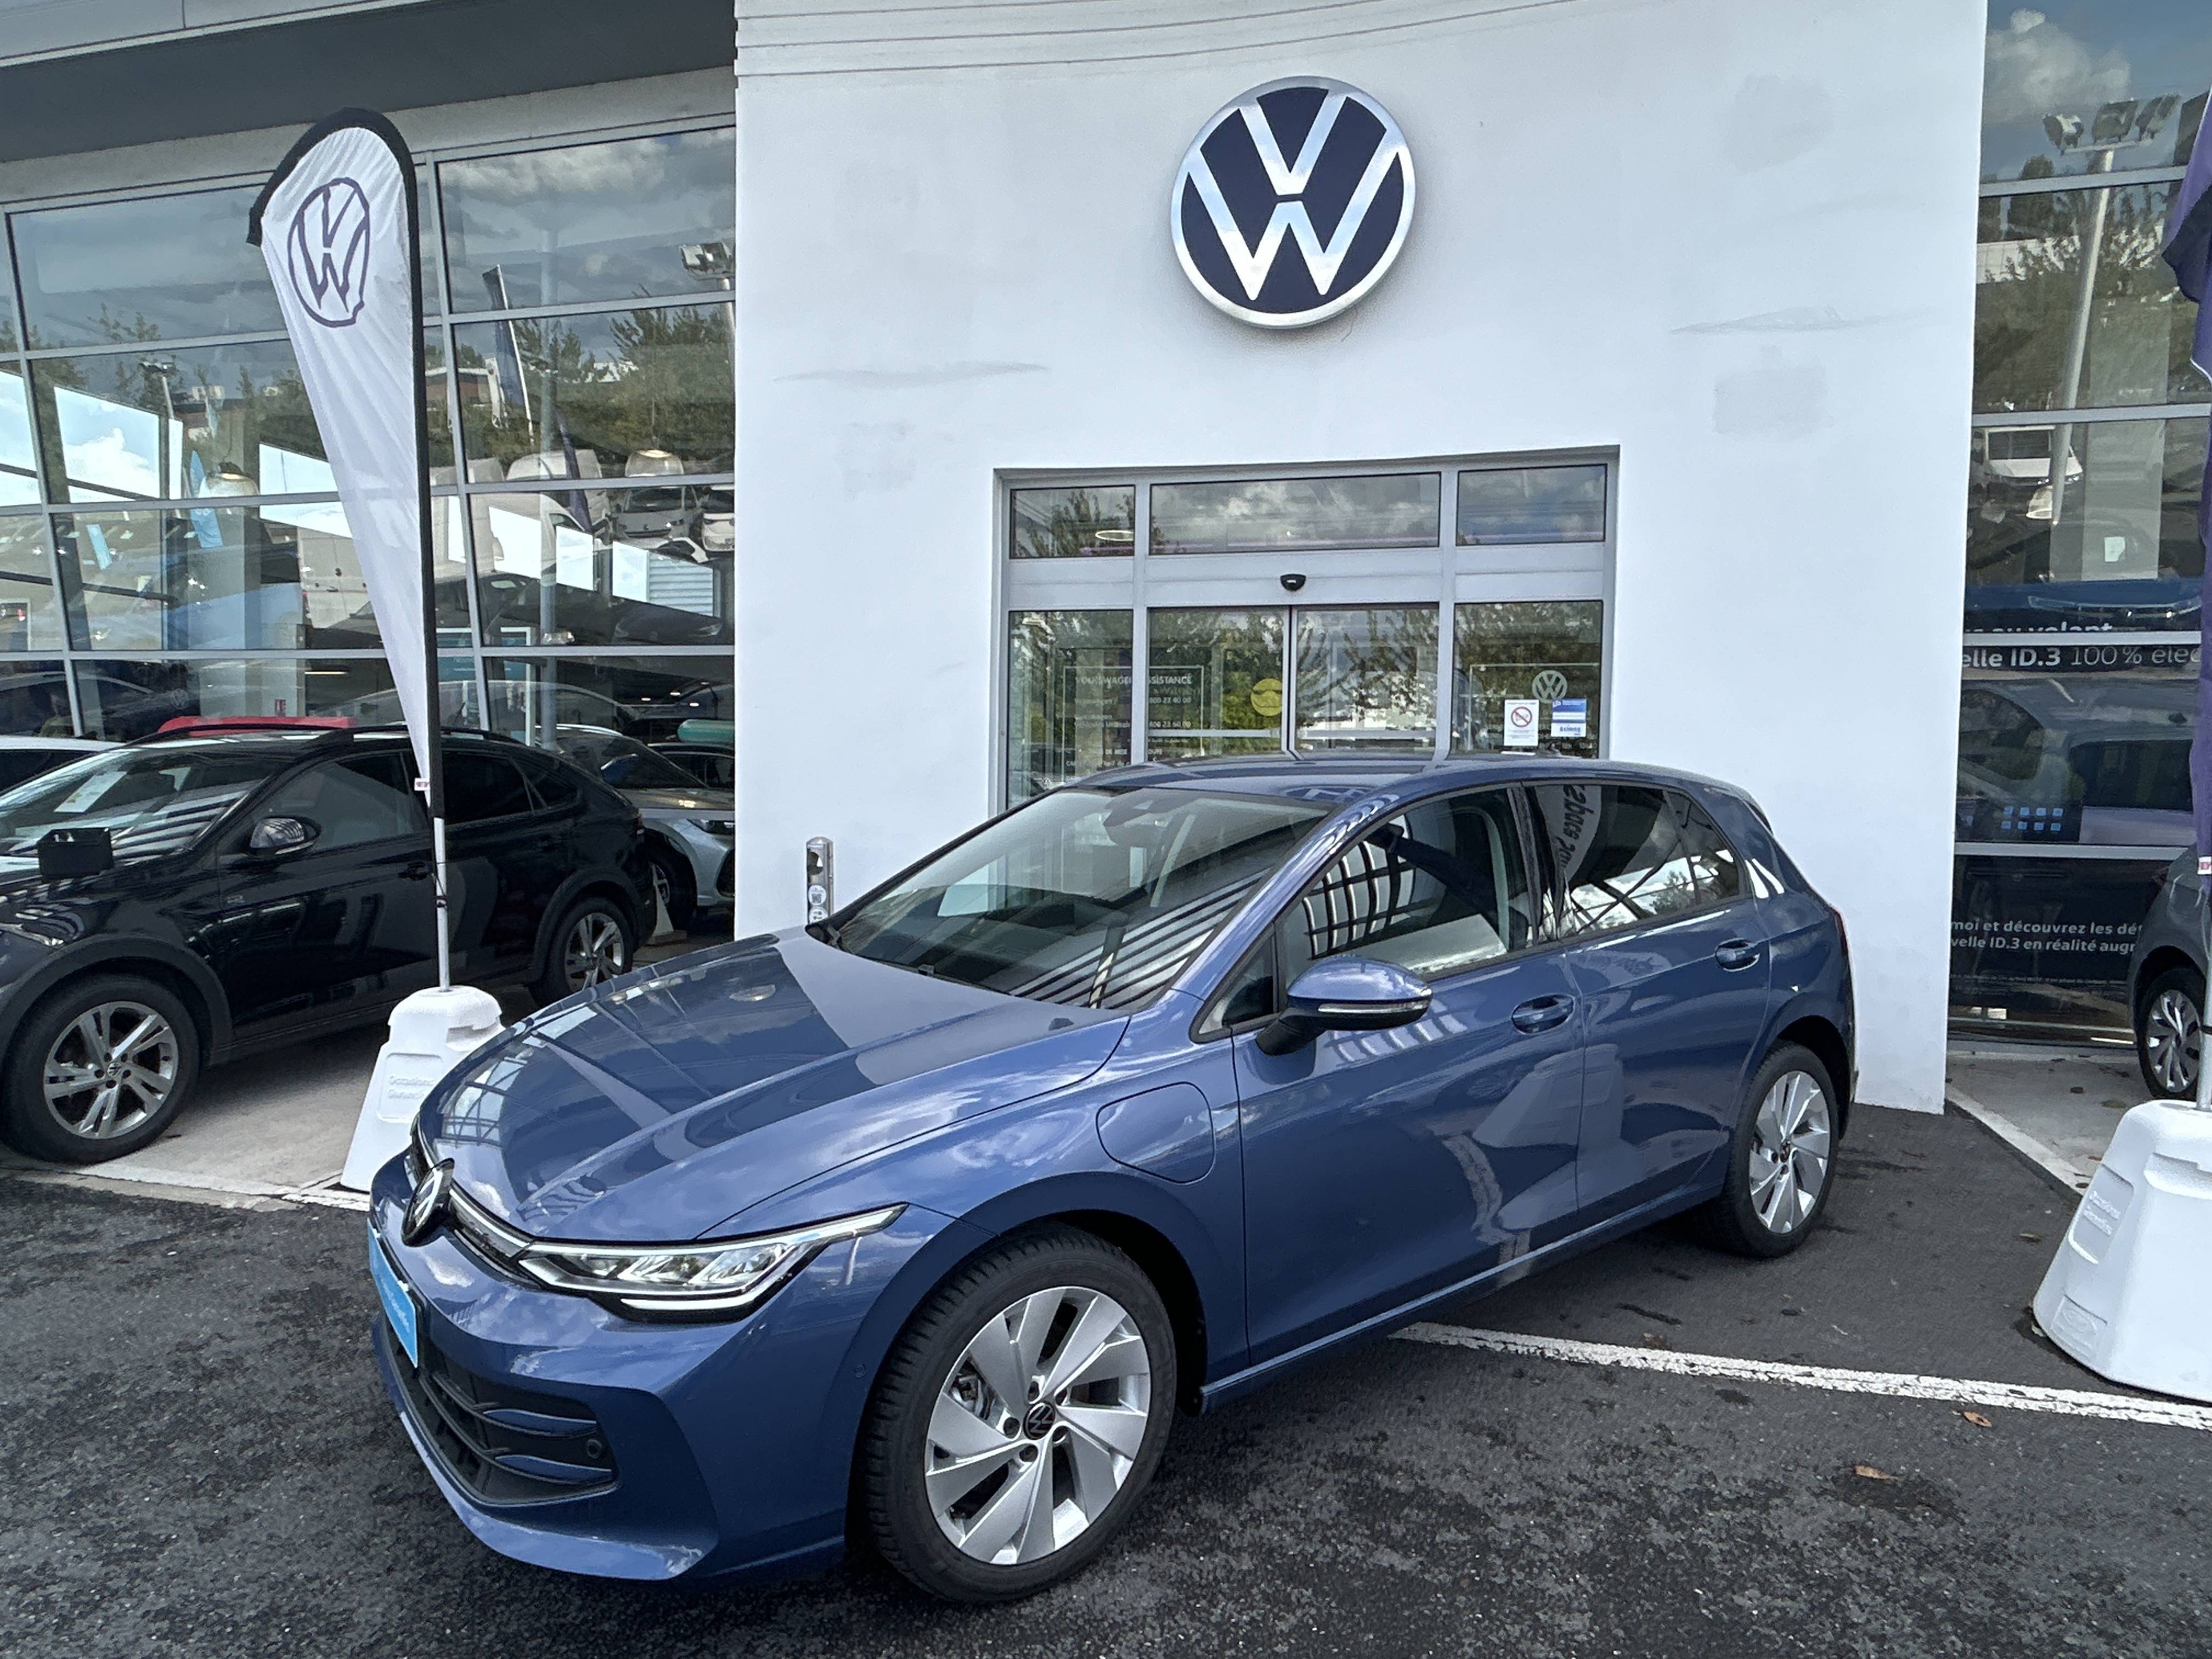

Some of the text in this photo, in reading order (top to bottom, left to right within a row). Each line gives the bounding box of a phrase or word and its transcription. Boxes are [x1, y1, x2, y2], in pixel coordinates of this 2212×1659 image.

[1180, 81, 1407, 307] VW
[2010, 648, 2061, 666] ID.3
[1983, 922, 2000, 932] et
[2003, 920, 2087, 934] découvrez
[2090, 922, 2113, 934] les
[1989, 936, 2020, 950] ID.3
[2023, 940, 2042, 950] en
[2045, 938, 2097, 951] réalité
